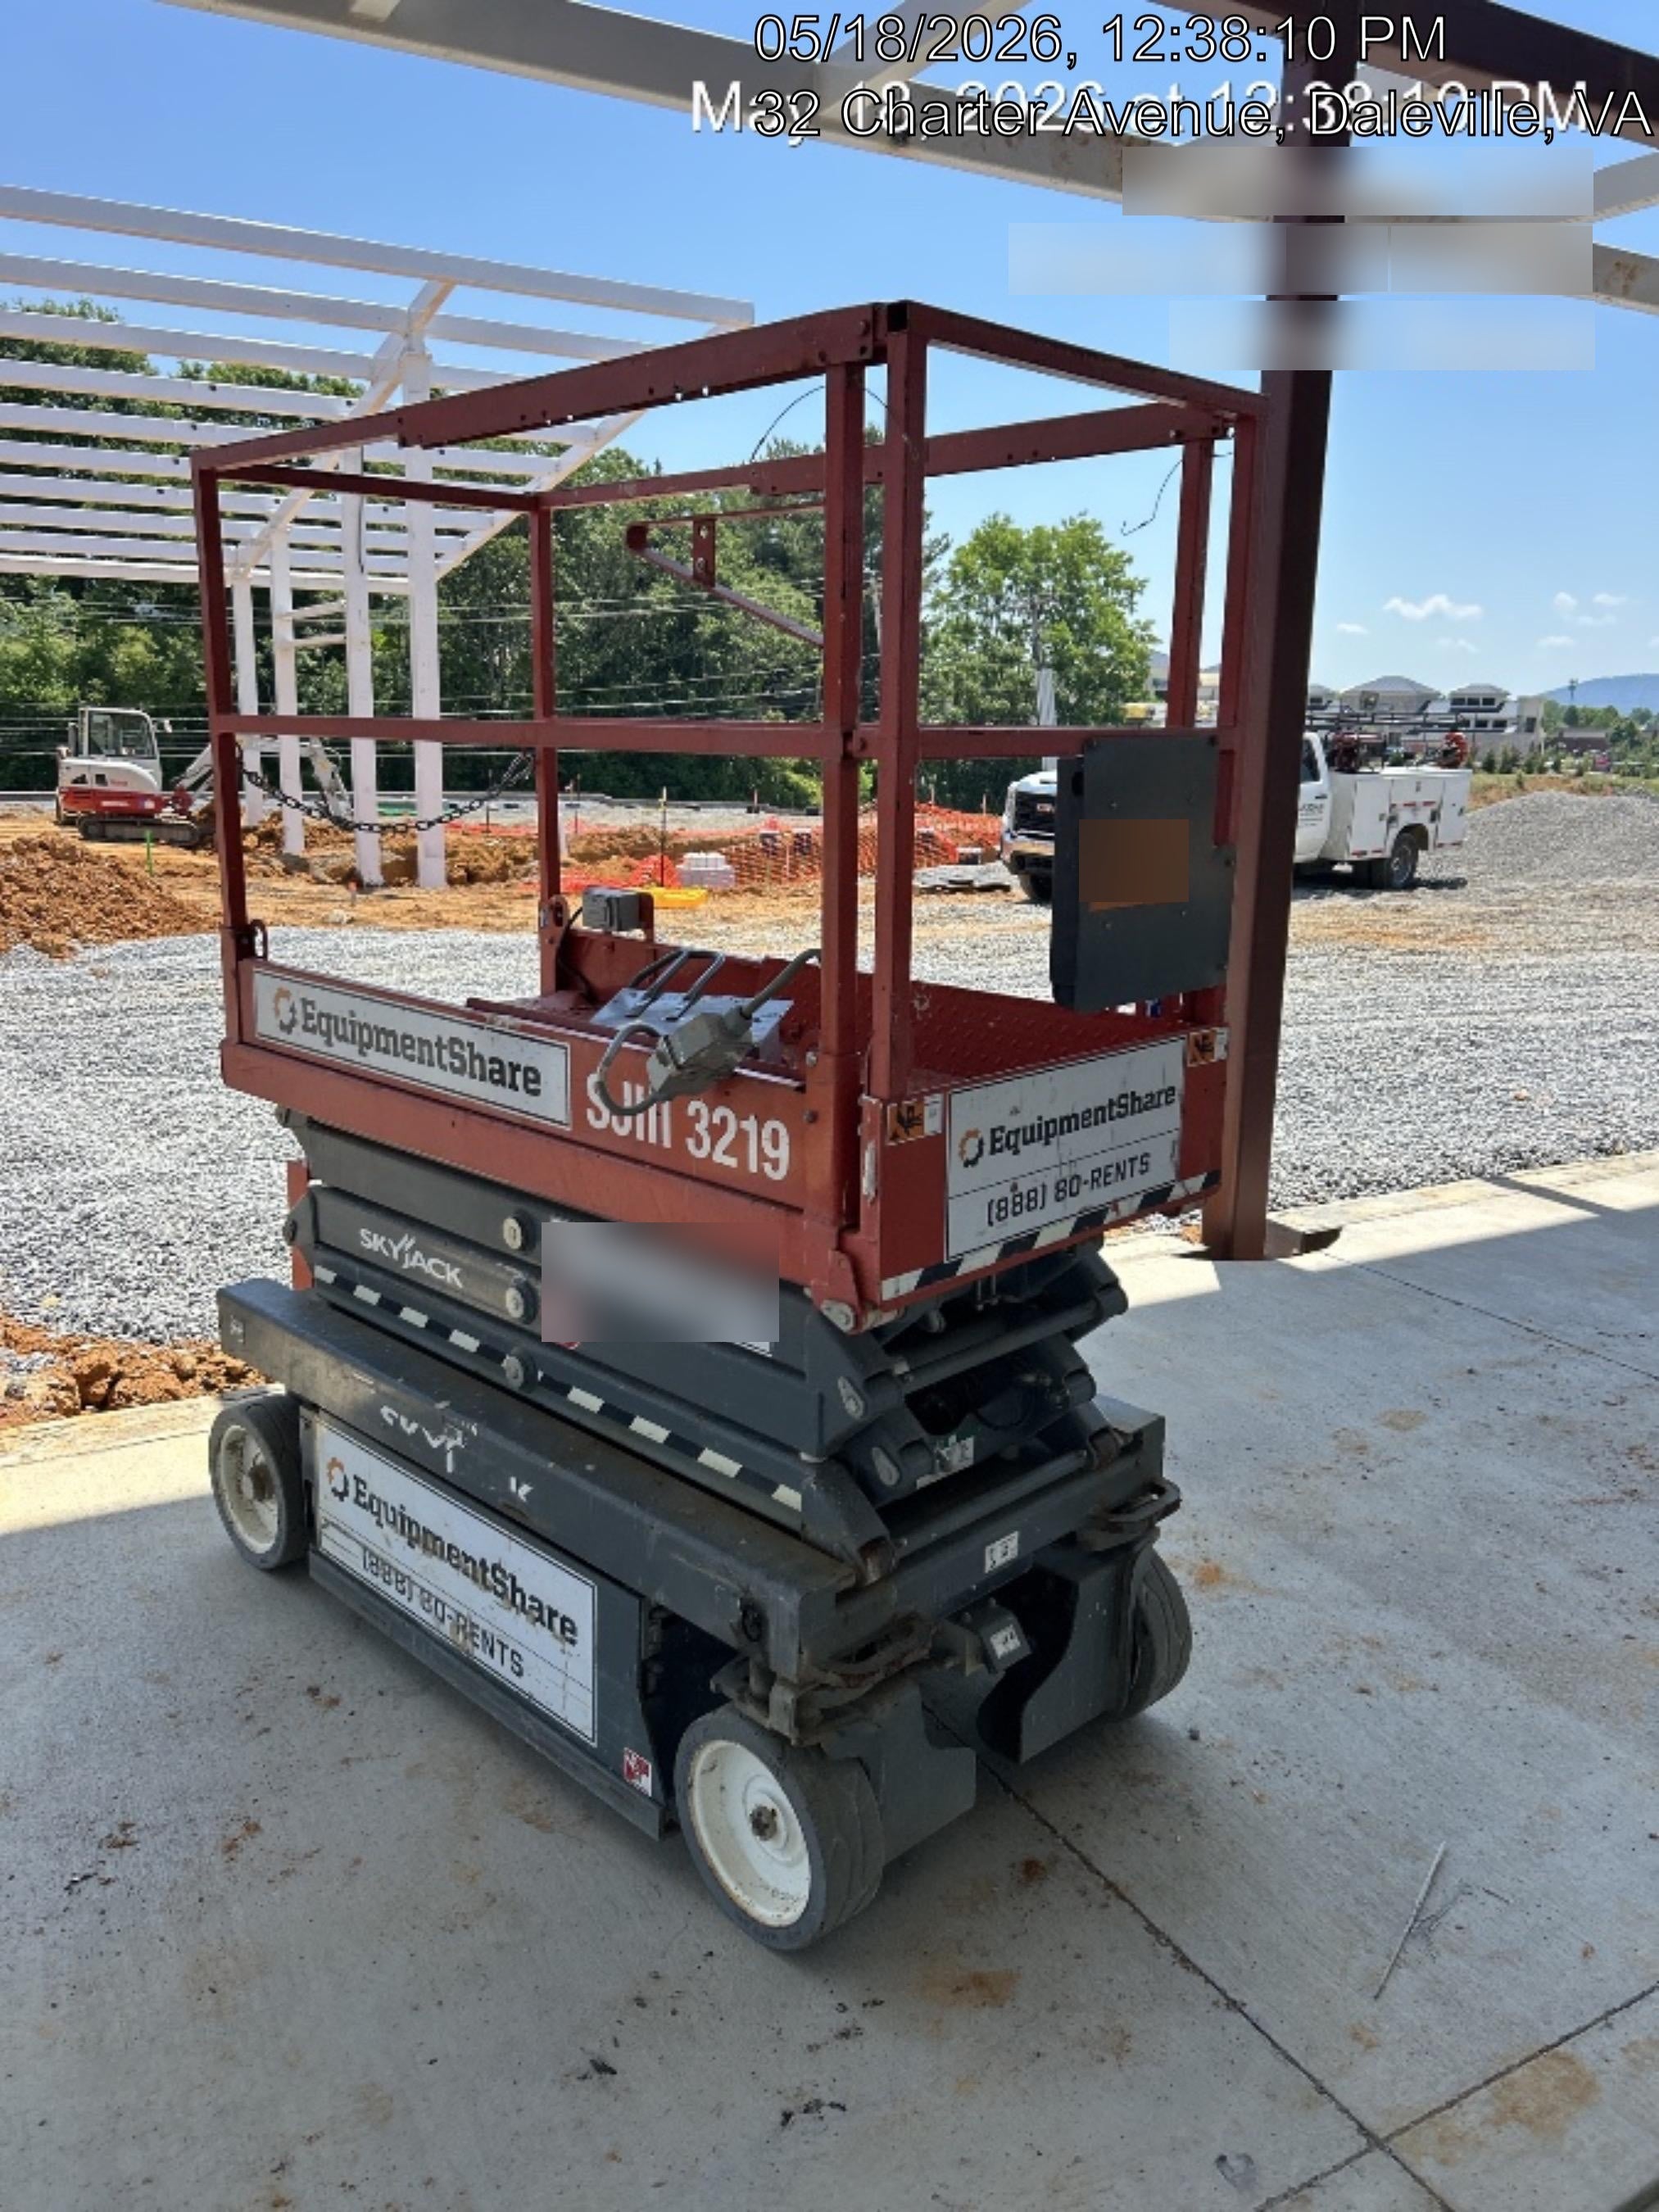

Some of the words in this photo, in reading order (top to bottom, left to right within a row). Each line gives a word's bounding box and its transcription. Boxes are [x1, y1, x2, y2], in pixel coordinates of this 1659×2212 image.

[301, 997, 542, 1096] EquipmentShare
[685, 1100, 791, 1181] 3219
[989, 1086, 1176, 1156] EquipmentShare
[987, 1182, 1048, 1226] (888)
[1054, 1152, 1151, 1203] 80-RENTS
[359, 1227, 464, 1289] SKYJACK
[353, 1475, 578, 1647] EquipmentShare
